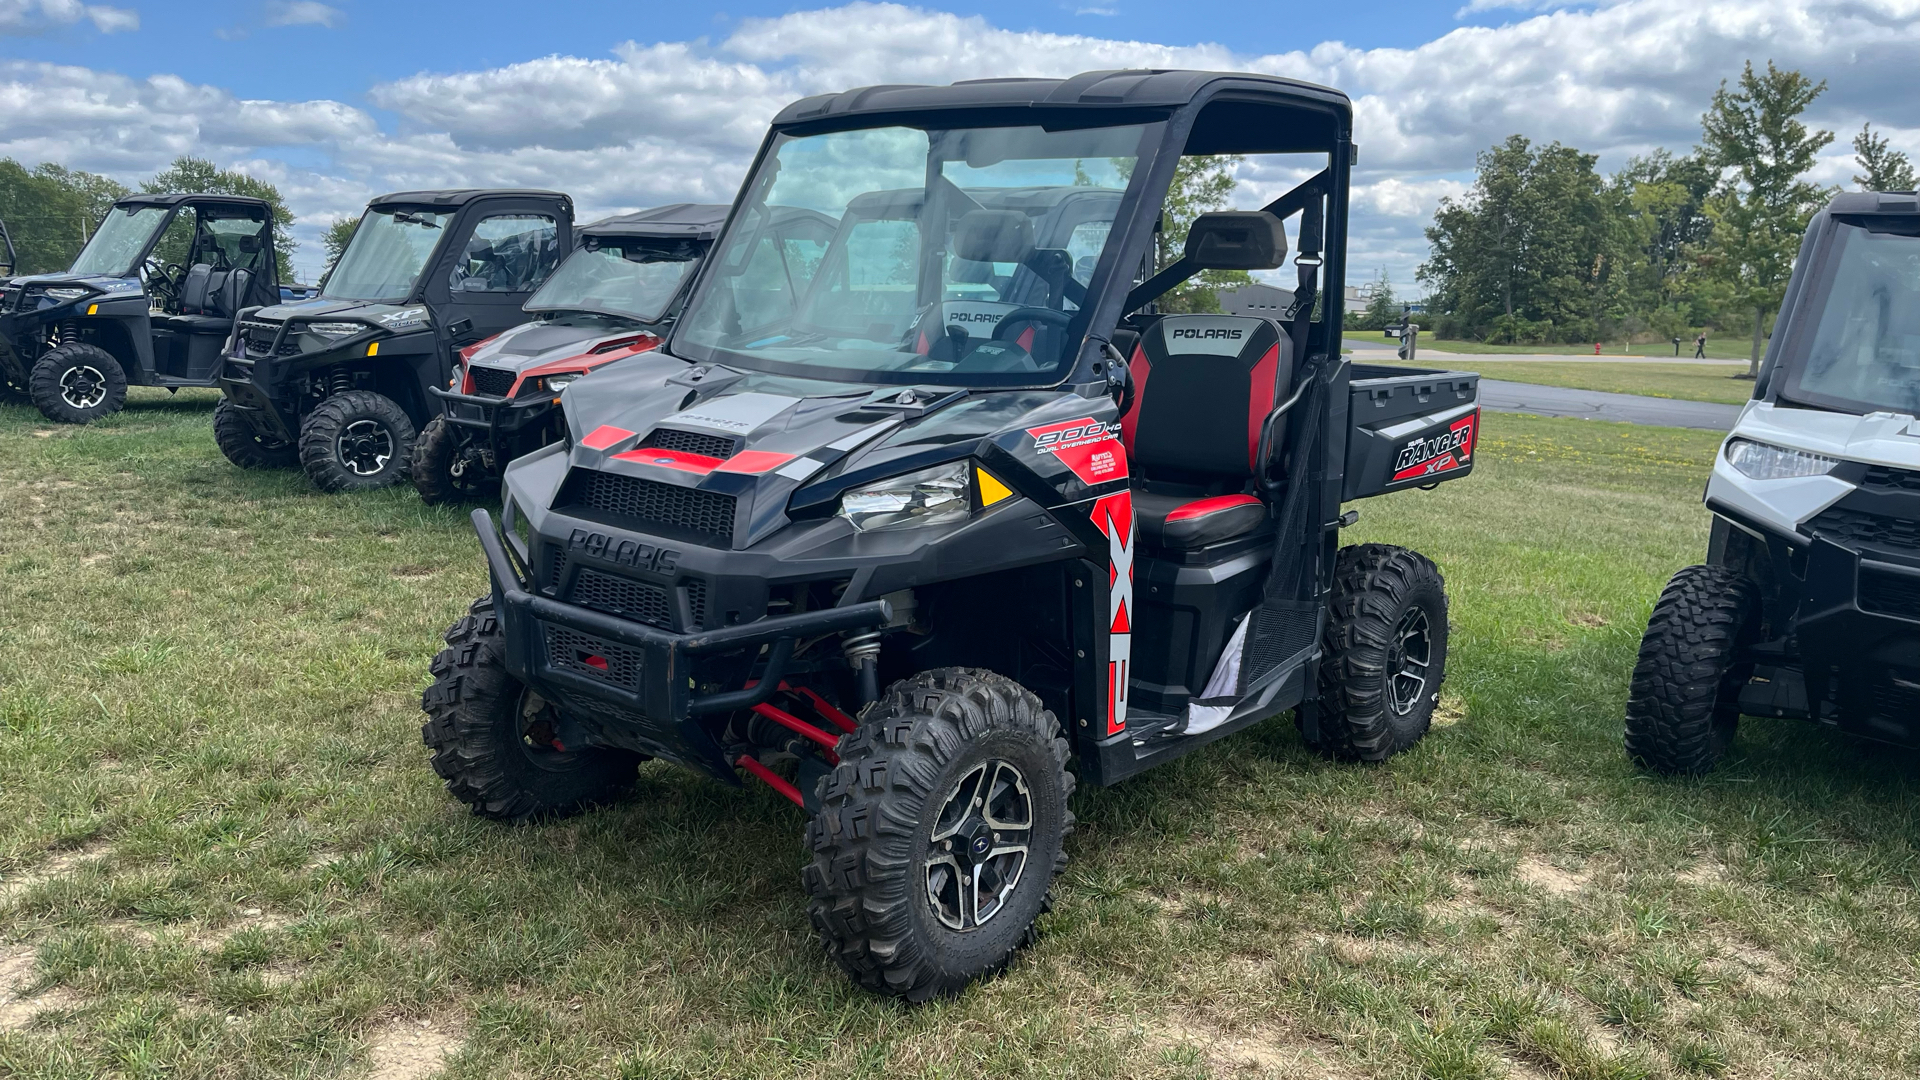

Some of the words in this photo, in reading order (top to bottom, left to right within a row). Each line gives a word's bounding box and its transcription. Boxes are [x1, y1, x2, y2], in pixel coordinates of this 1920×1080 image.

[379, 309, 423, 323] XP
[1173, 329, 1243, 340] POLARIS
[1034, 421, 1107, 448] 900
[1105, 423, 1122, 431] HD
[1037, 446, 1059, 454] DUAL
[1061, 437, 1101, 450] OVERHEAD
[1102, 433, 1119, 441] CAM
[1395, 424, 1470, 472] RANGER
[1424, 455, 1452, 475] XP
[568, 528, 681, 576] POLARIS
[1107, 508, 1134, 726] XP
